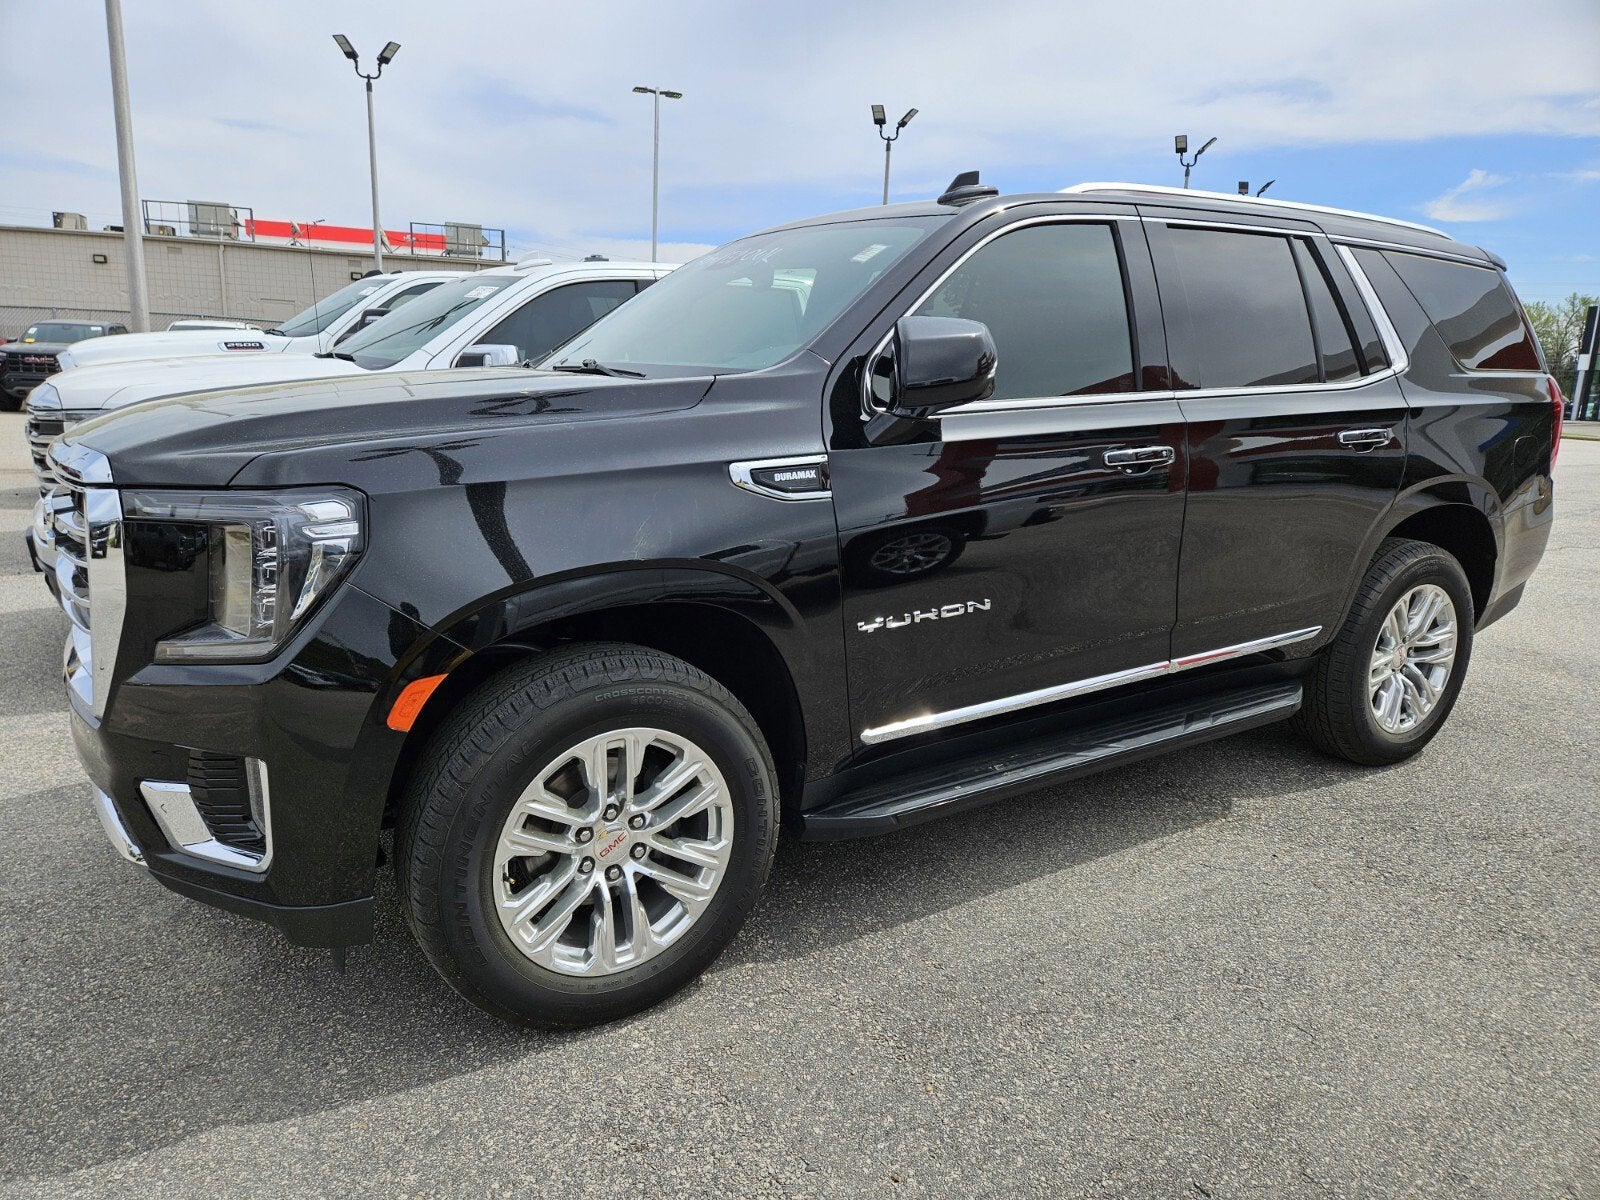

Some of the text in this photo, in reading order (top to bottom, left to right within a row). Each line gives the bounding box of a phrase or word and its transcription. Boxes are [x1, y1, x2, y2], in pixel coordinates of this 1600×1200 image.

[24, 356, 55, 364] GMC
[773, 469, 817, 482] DURAMAX
[857, 598, 992, 634] YUKON
[600, 831, 627, 858] GMC
